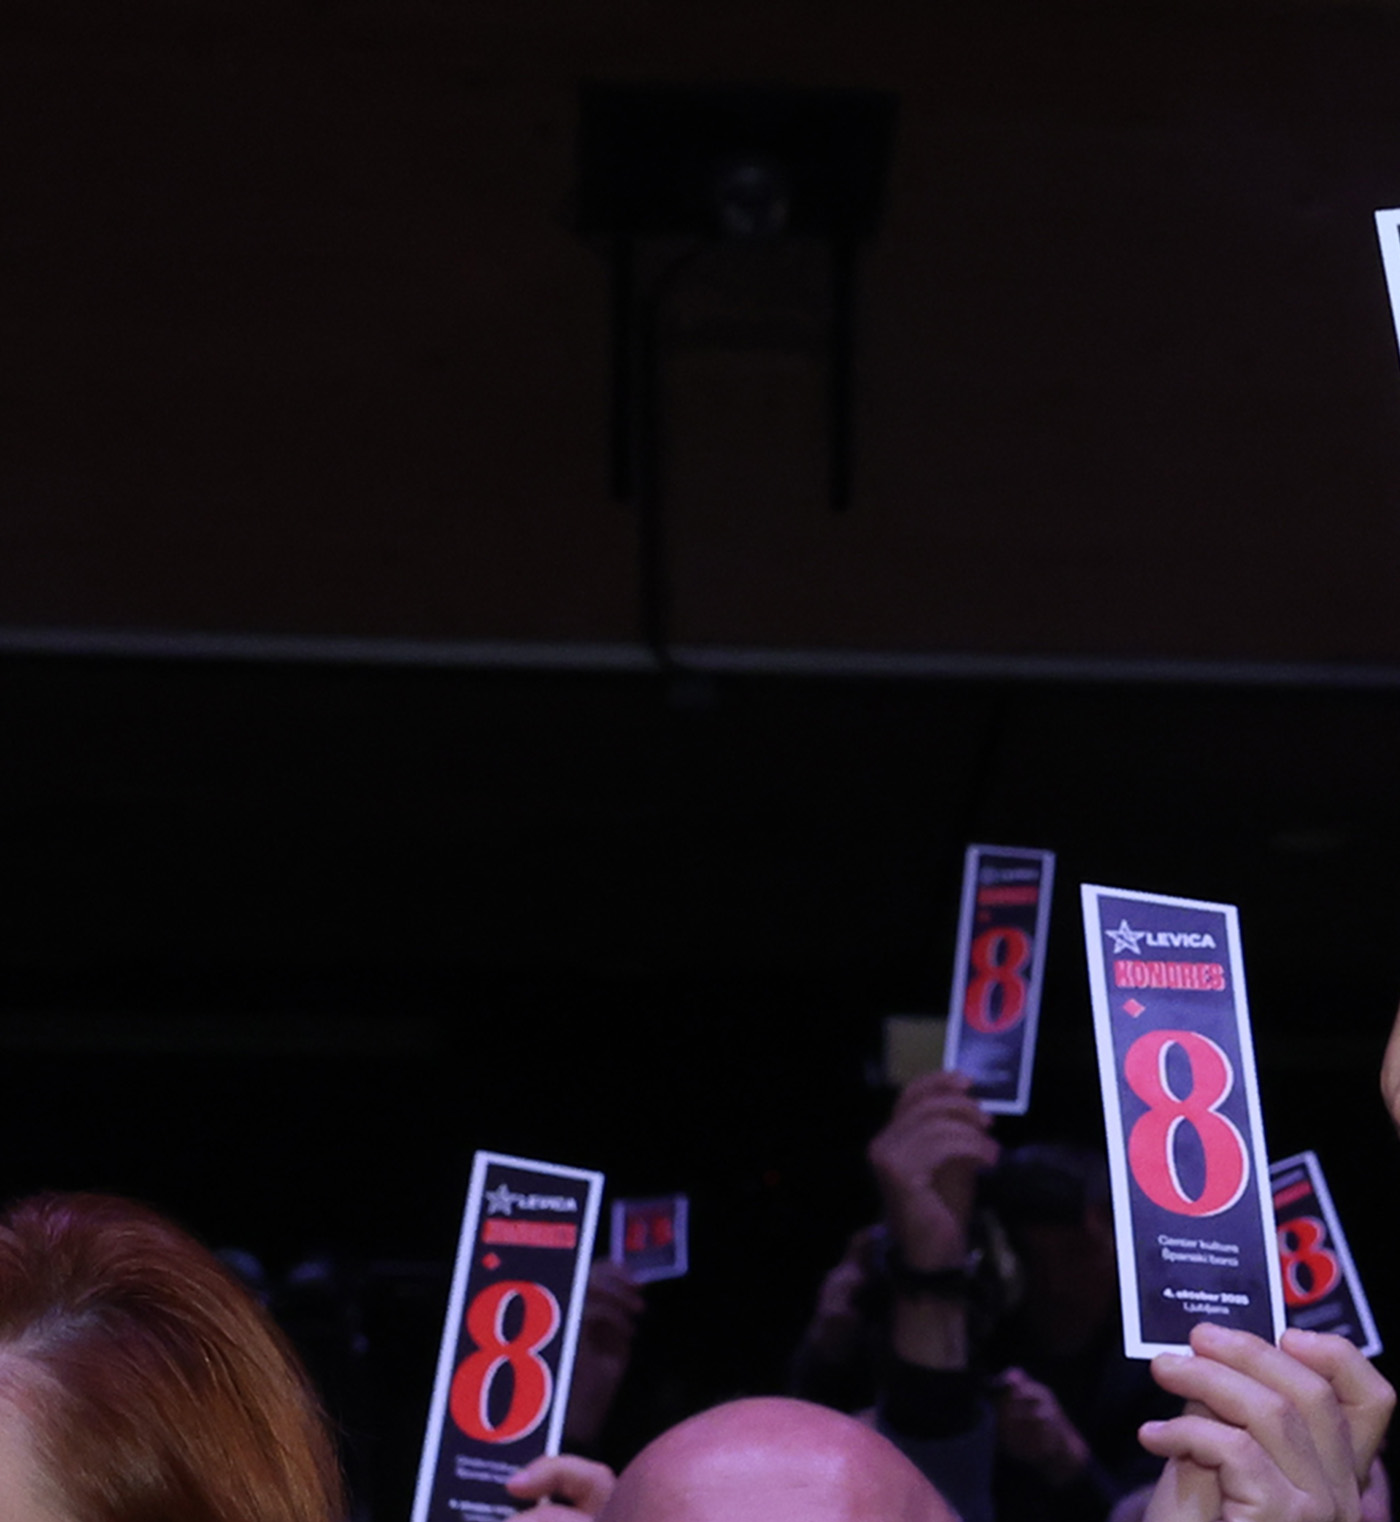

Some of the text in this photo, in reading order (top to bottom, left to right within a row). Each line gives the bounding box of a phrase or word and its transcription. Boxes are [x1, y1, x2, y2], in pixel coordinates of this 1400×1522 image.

[963, 925, 1031, 1035] 8
[1114, 960, 1226, 991] KONGRES
[1146, 932, 1217, 949] LEVICA
[1123, 1029, 1250, 1218] 8
[450, 1279, 560, 1445] 8
